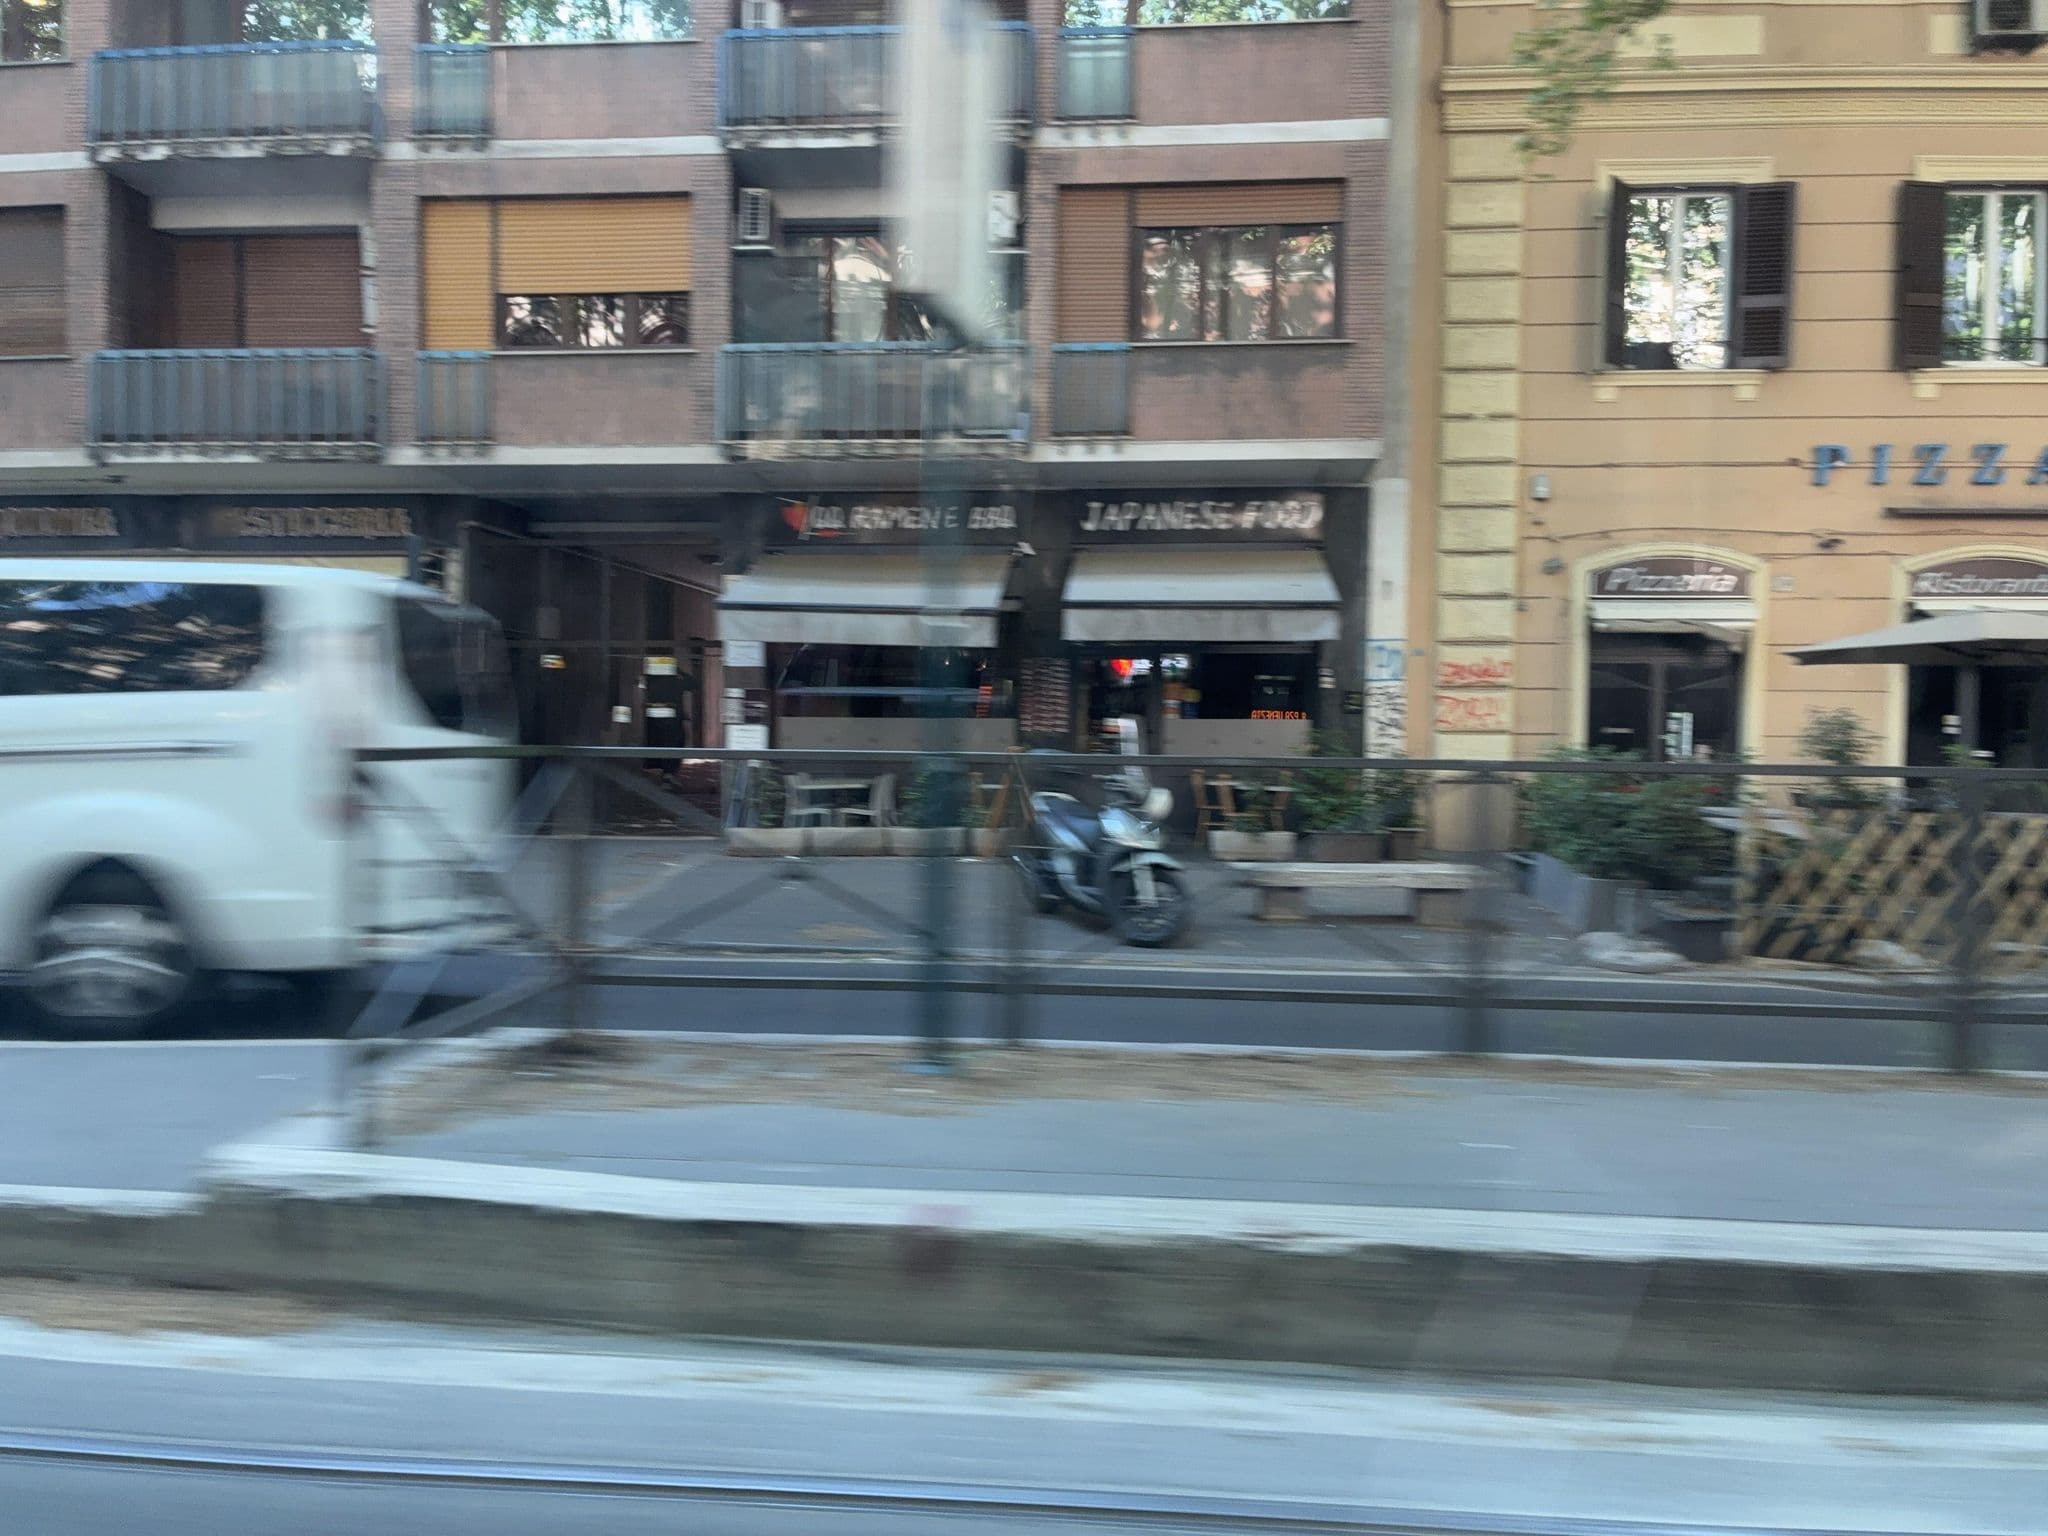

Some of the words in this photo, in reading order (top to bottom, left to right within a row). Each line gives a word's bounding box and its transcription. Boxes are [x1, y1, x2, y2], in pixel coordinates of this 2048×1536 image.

[1080, 501, 1235, 531] JAPANESE
[1241, 500, 1324, 529] FOOD
[1604, 567, 1739, 592] Pizzeria
